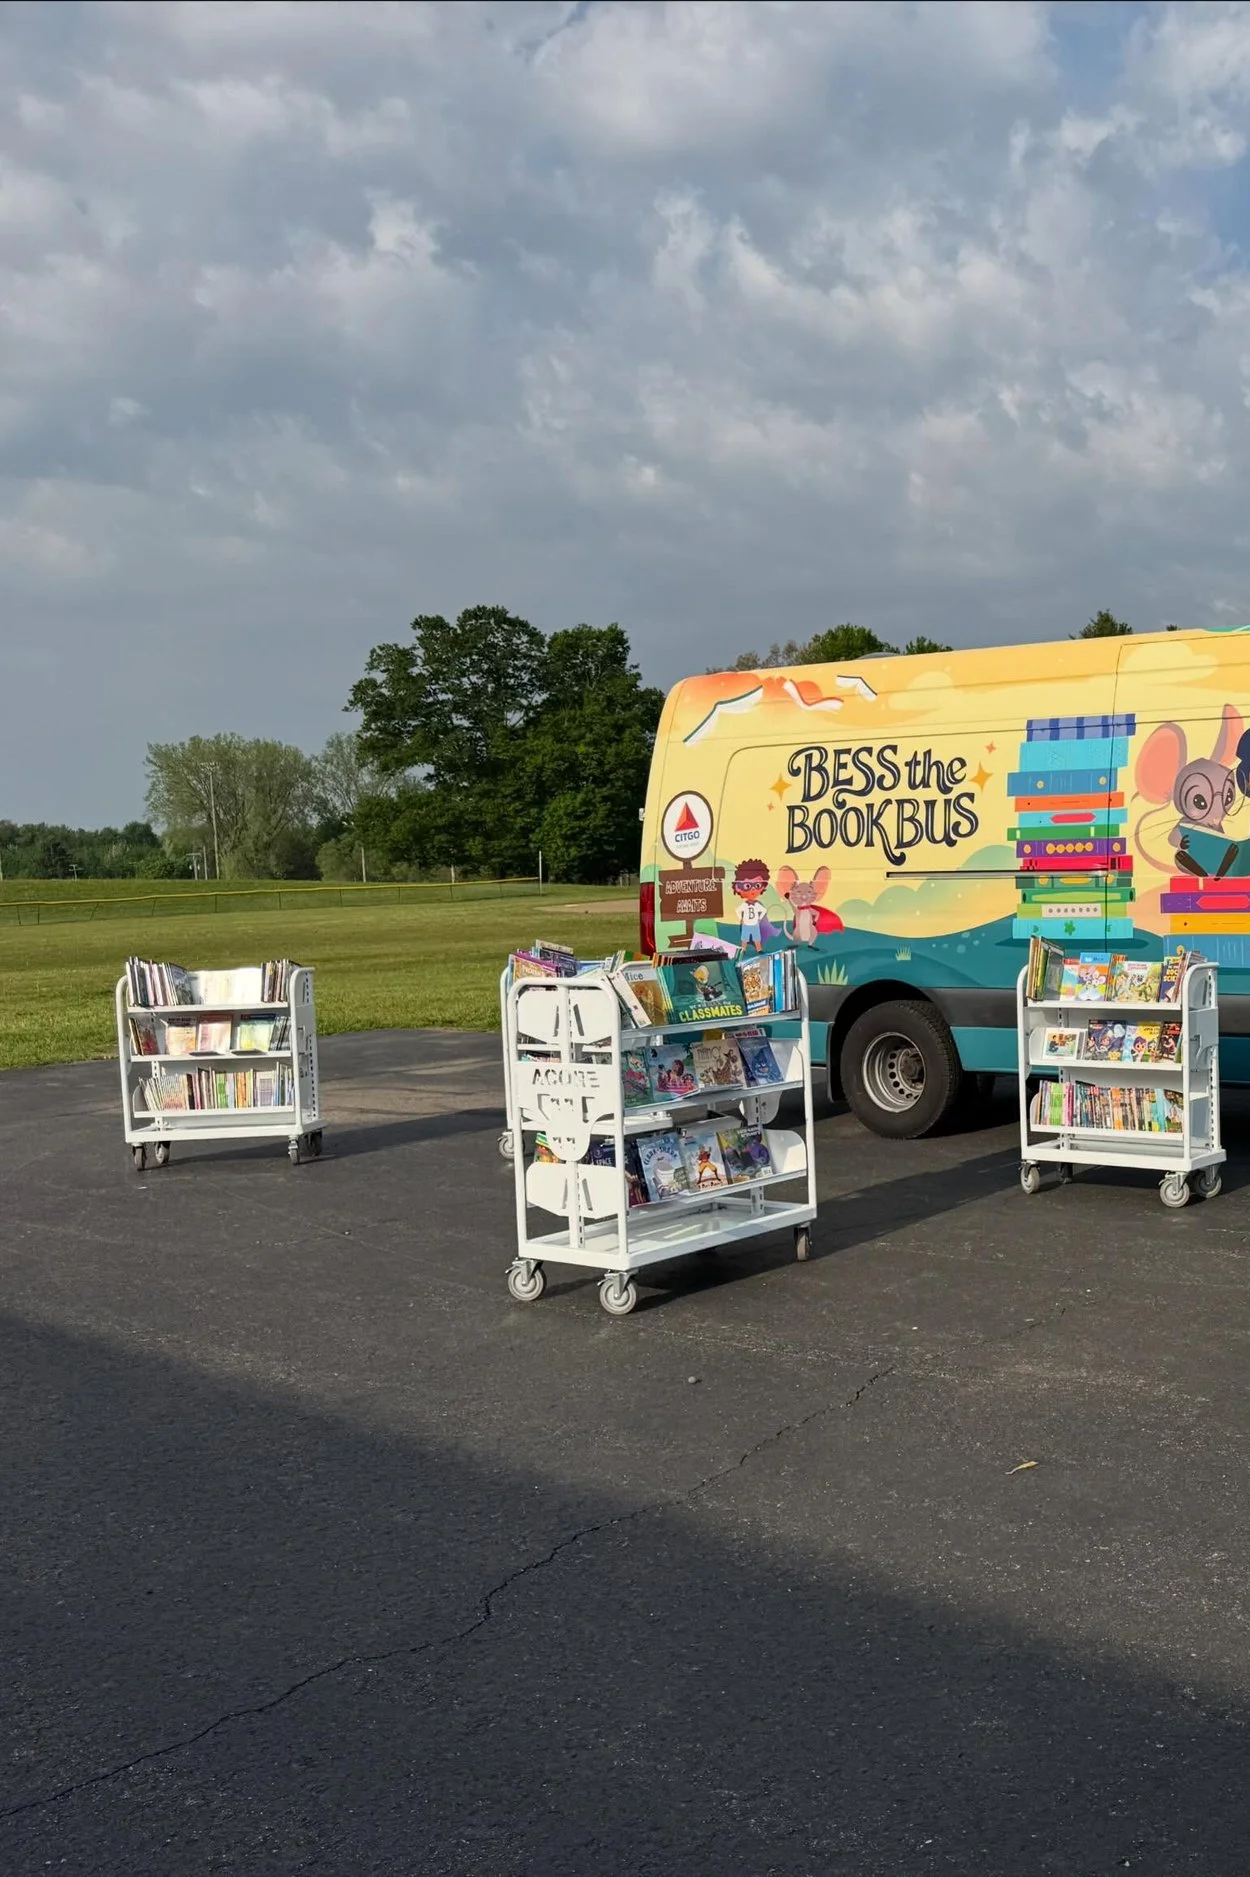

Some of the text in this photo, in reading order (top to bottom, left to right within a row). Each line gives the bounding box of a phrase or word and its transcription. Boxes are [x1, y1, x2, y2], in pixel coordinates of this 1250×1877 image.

[787, 745, 967, 809] BESS the
[675, 831, 700, 842] CITGO
[665, 878, 717, 894] ADVENTURE
[676, 899, 708, 914] AWAITS
[748, 907, 756, 920] B
[679, 1005, 743, 1022] CLASSMATES
